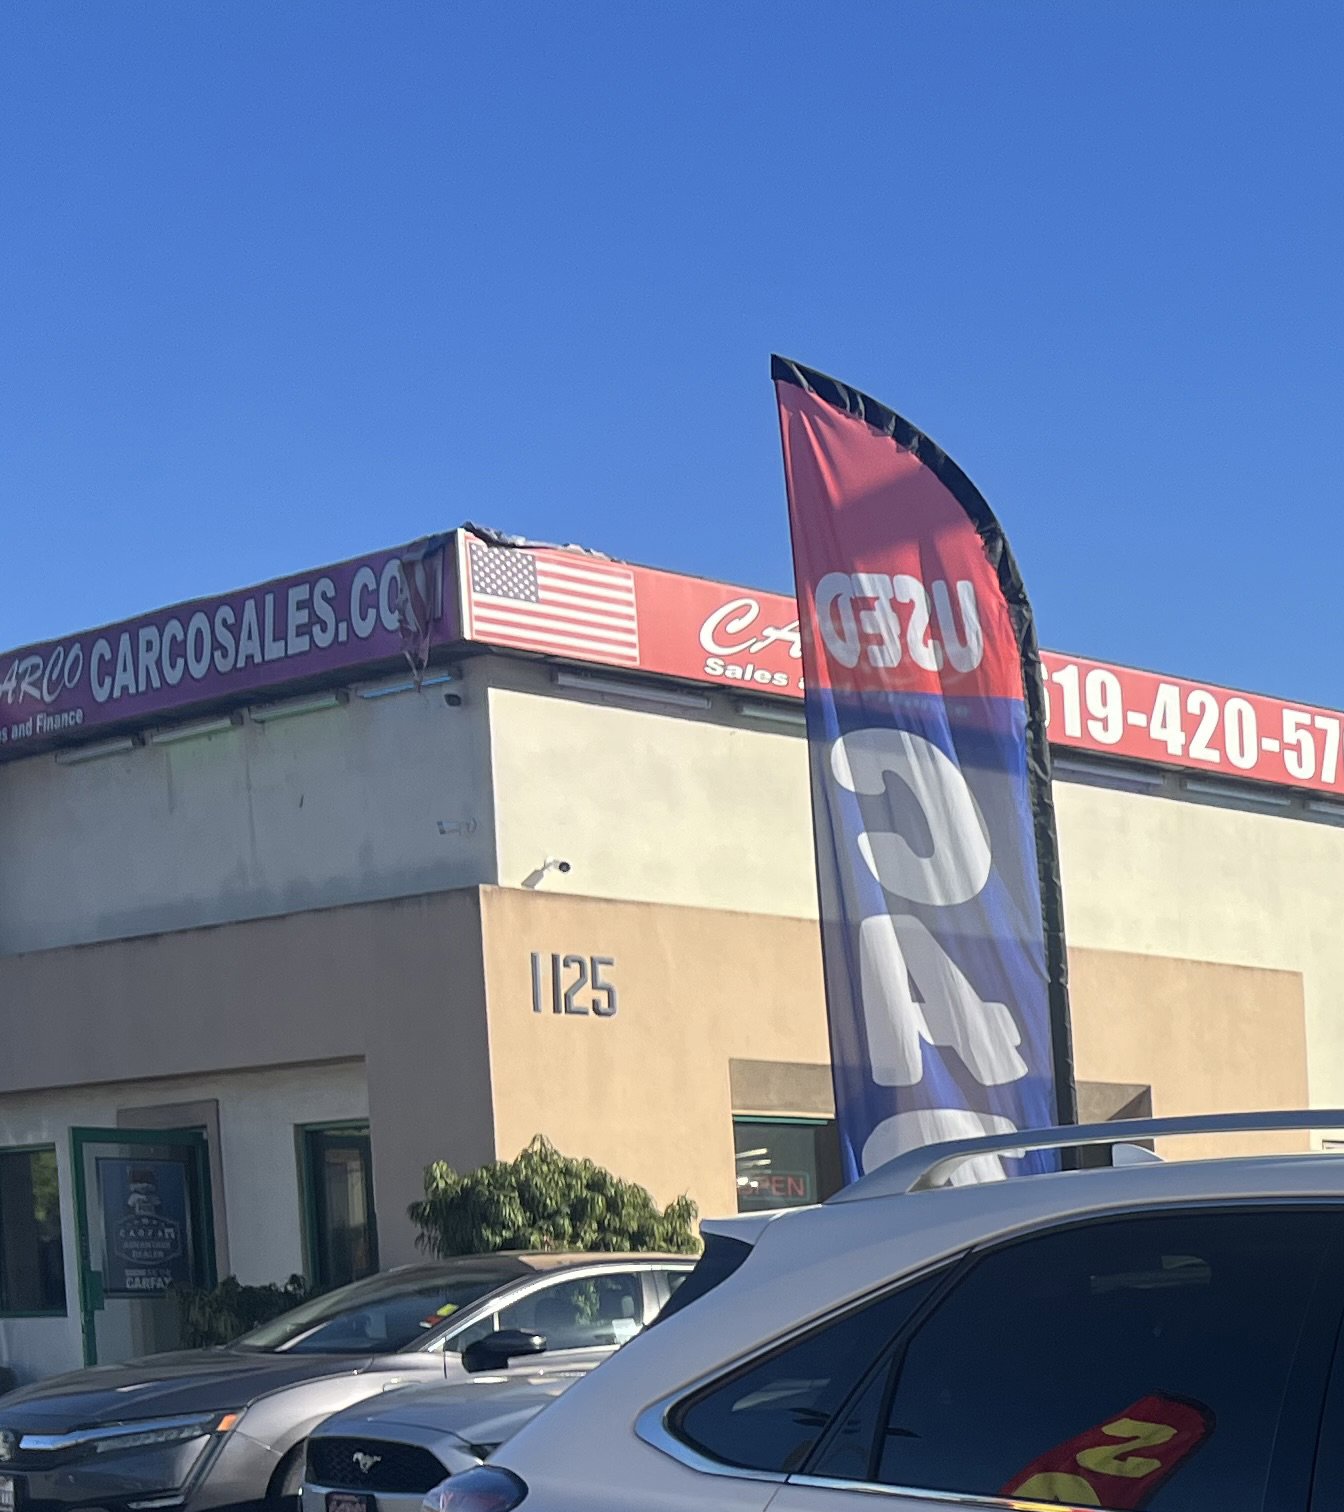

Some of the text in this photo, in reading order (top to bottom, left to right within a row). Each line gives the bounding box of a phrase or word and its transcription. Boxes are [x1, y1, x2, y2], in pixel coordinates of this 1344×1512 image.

[0, 642, 83, 704] ARCO
[704, 657, 789, 687] Sales
[11, 717, 33, 740] and
[36, 708, 84, 734] Finance
[529, 951, 617, 1018] 1125
